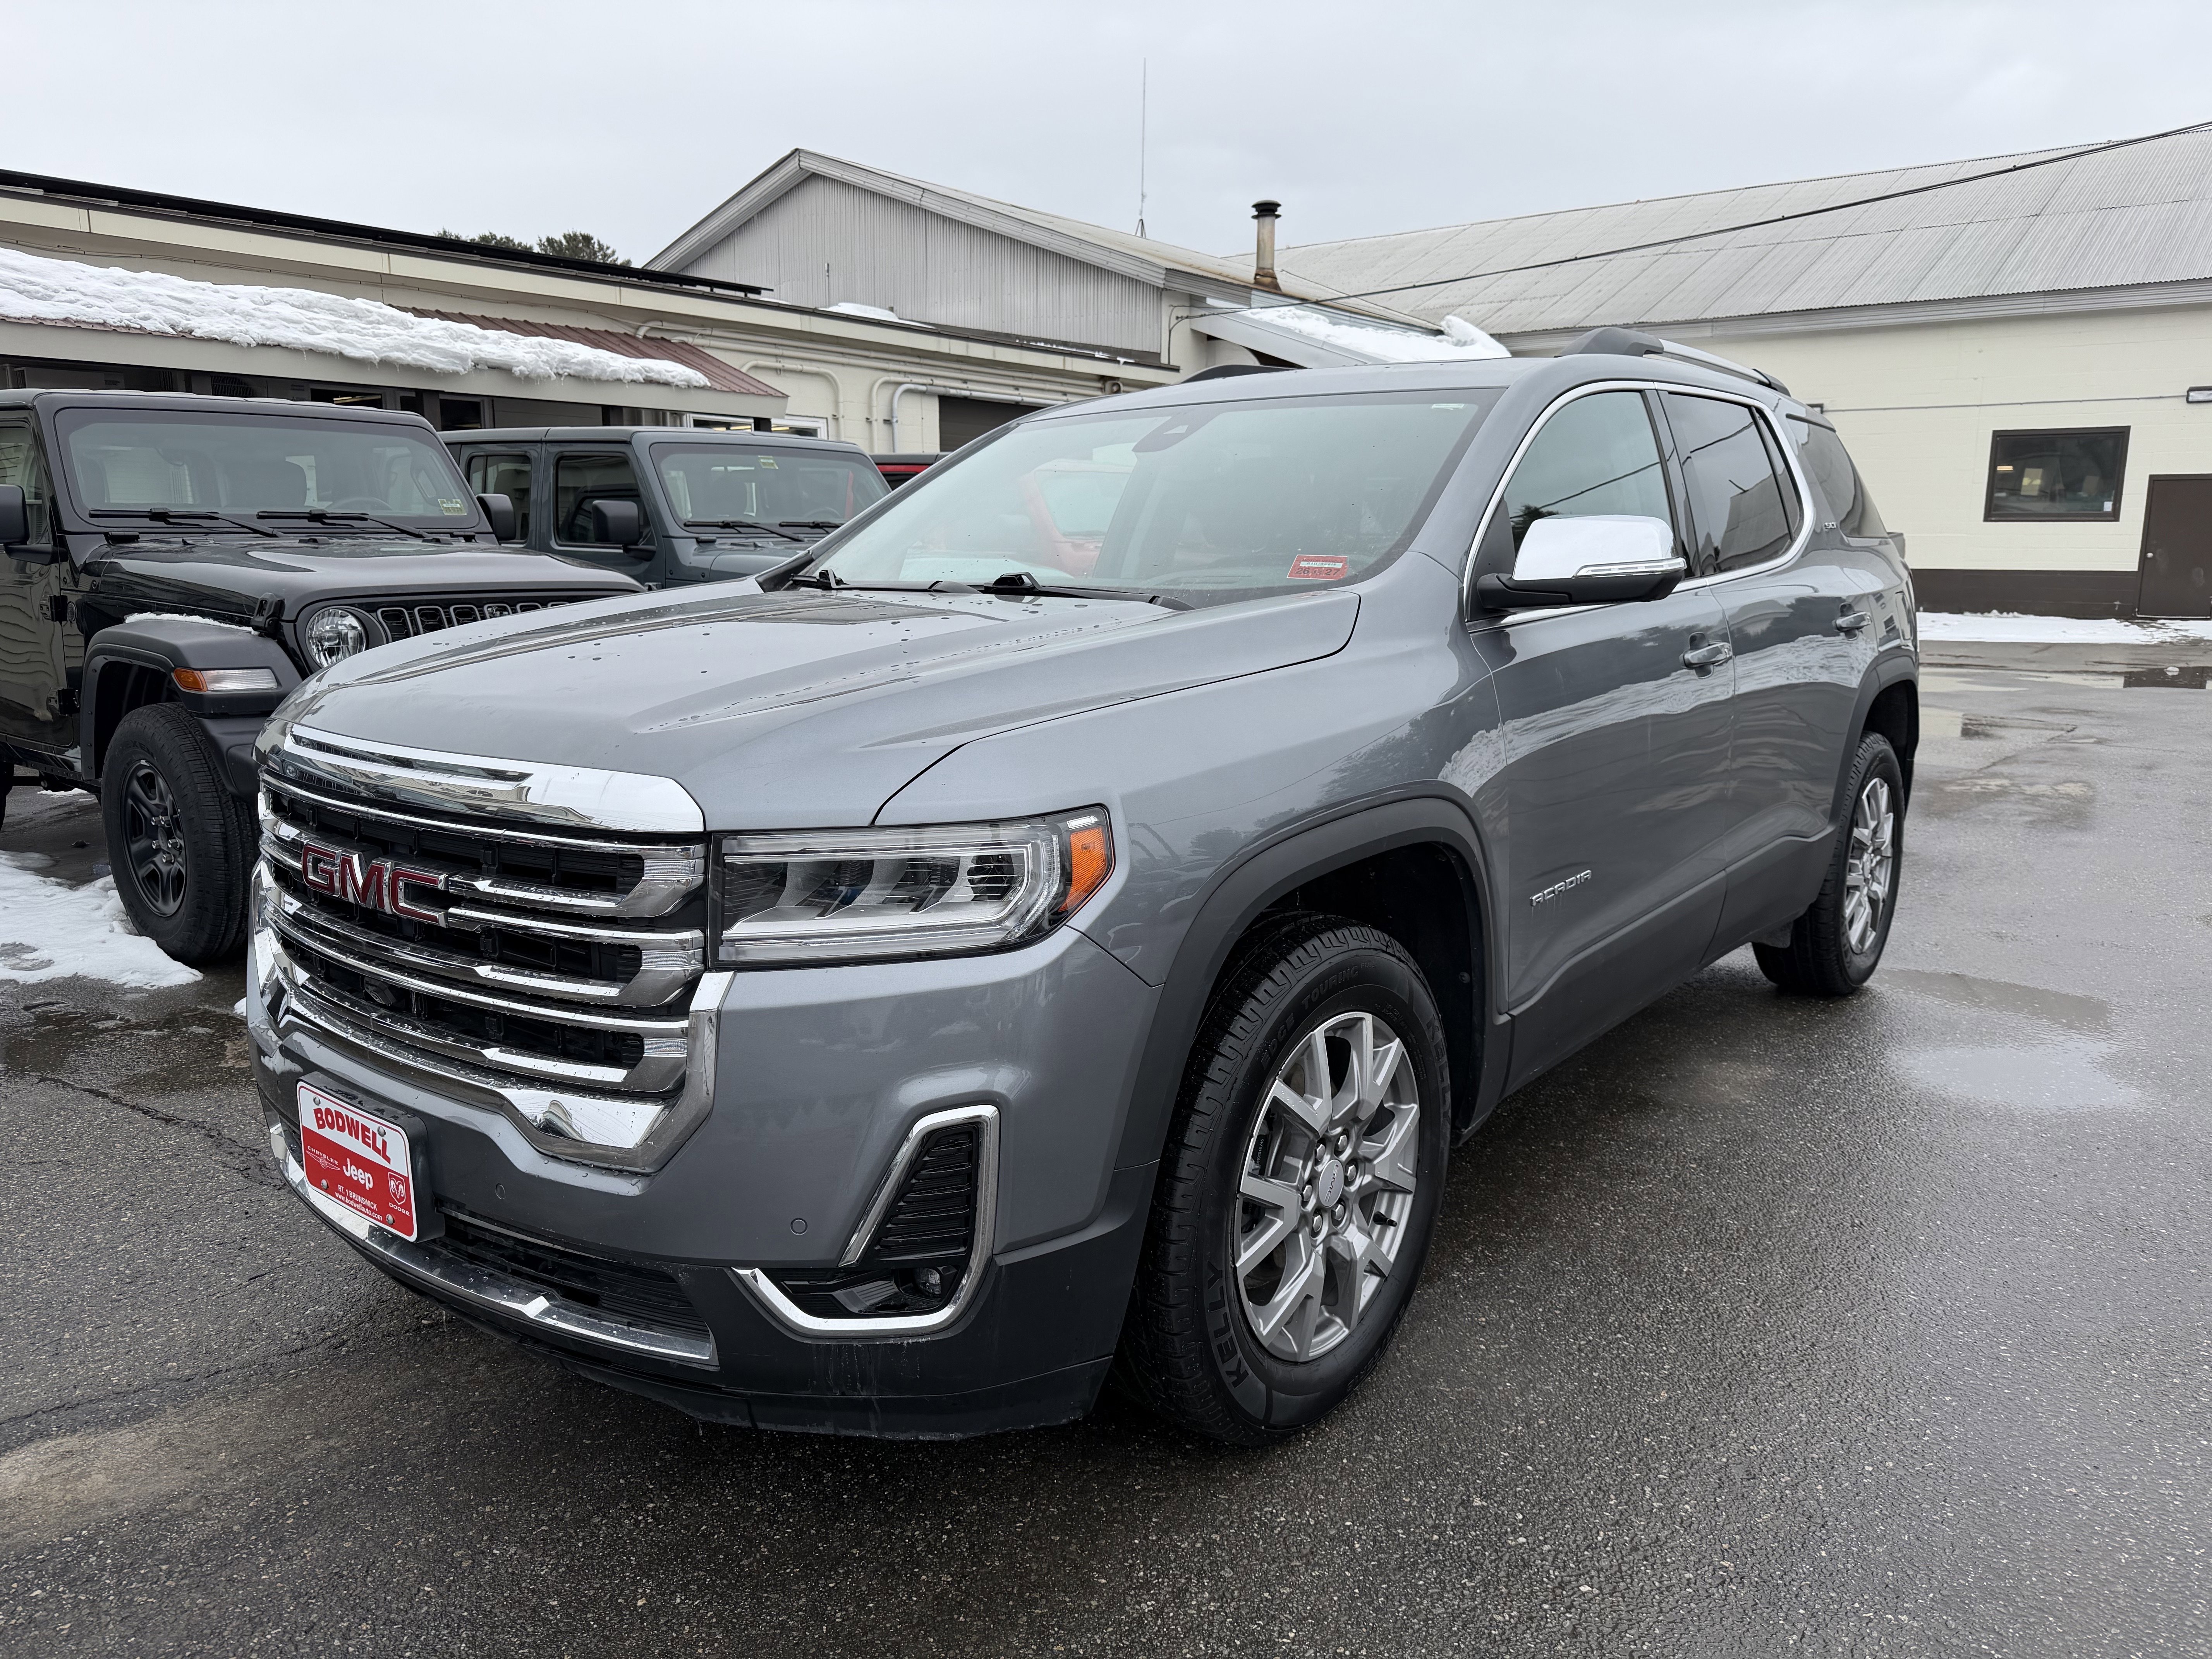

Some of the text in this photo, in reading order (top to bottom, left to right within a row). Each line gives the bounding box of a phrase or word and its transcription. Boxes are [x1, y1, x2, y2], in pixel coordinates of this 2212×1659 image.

[302, 841, 448, 928] GMC
[1530, 870, 1592, 907] ACADIA
[1260, 1012, 1296, 1071] EDGE
[1300, 965, 1360, 1010] TOURING
[313, 1107, 391, 1165] BODWELL
[307, 1146, 339, 1166] CHRYSLER
[343, 1158, 374, 1190] Jeep
[349, 1190, 378, 1211] BRUNSWICK
[1324, 1164, 1339, 1203] GMC
[335, 1192, 383, 1221] www.bodwellauto.com
[388, 1202, 410, 1216] DODGE
[1207, 1260, 1250, 1389] KELLY
